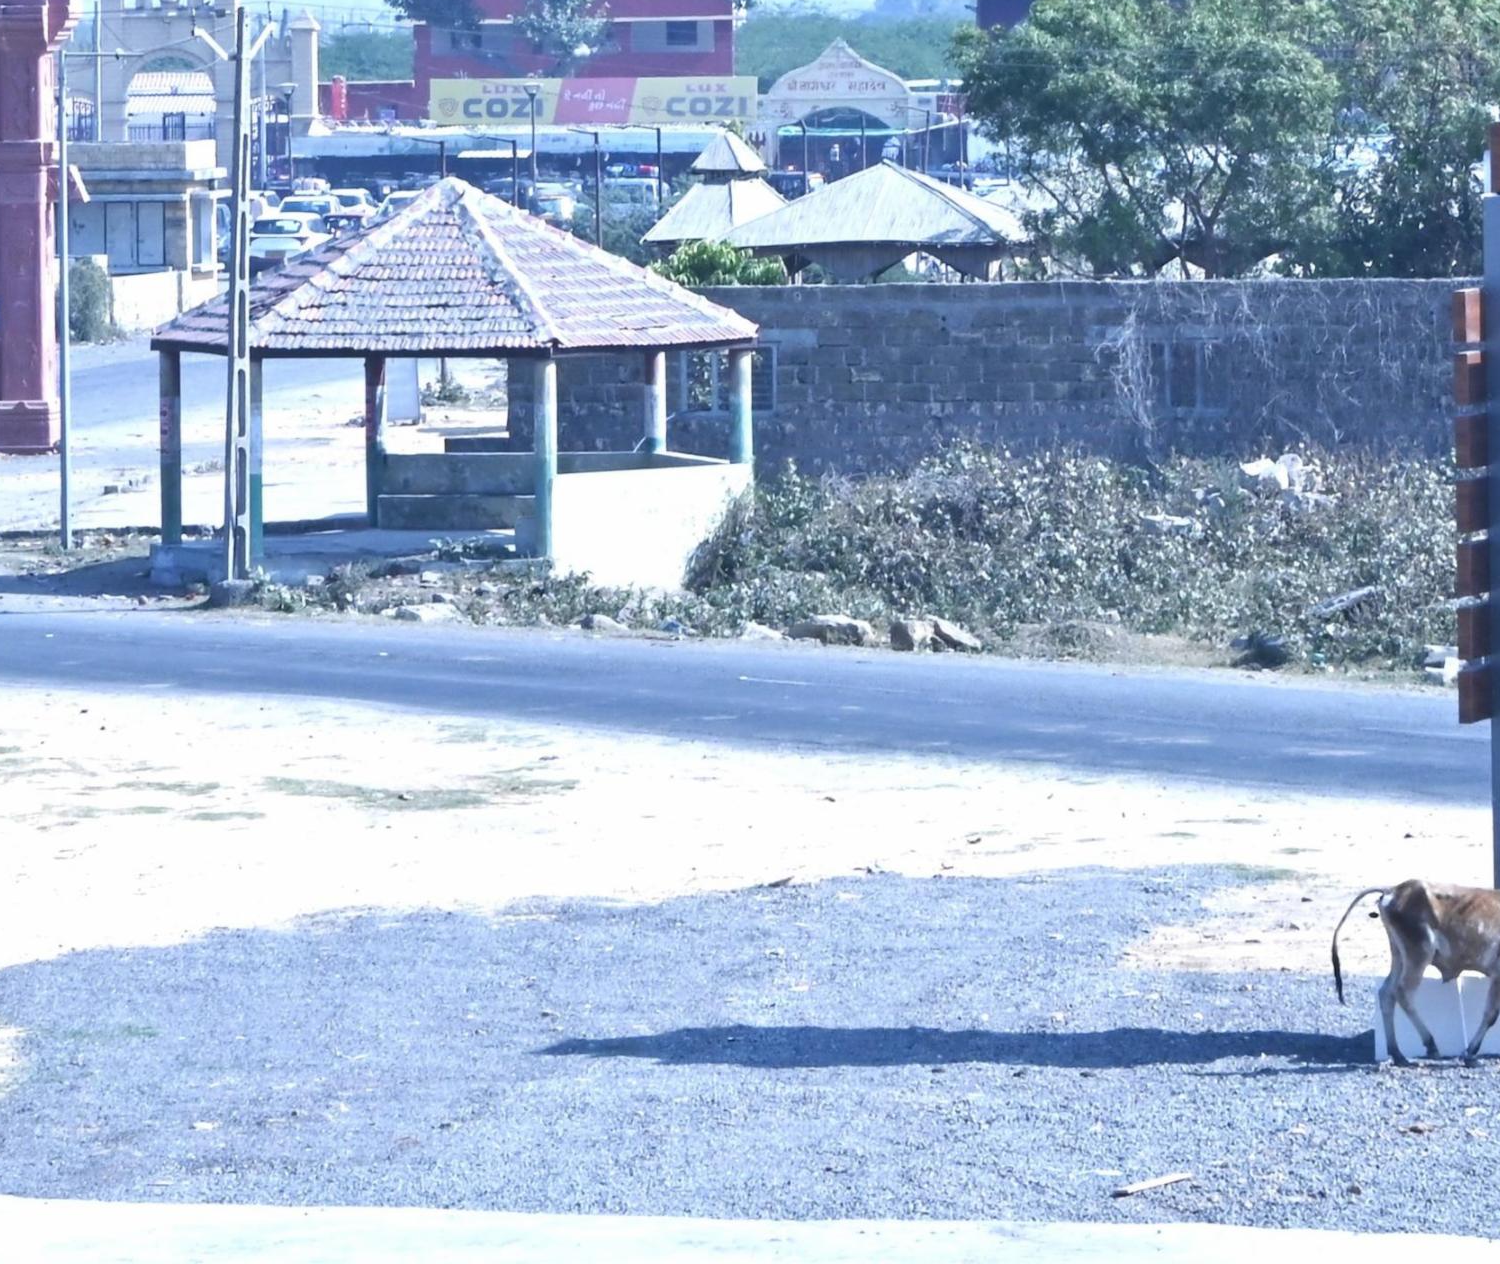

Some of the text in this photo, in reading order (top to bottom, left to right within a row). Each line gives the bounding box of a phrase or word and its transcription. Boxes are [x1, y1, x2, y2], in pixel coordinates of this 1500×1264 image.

[685, 84, 727, 93] LUX
[463, 97, 543, 119] COZI
[665, 96, 748, 118] COZI
